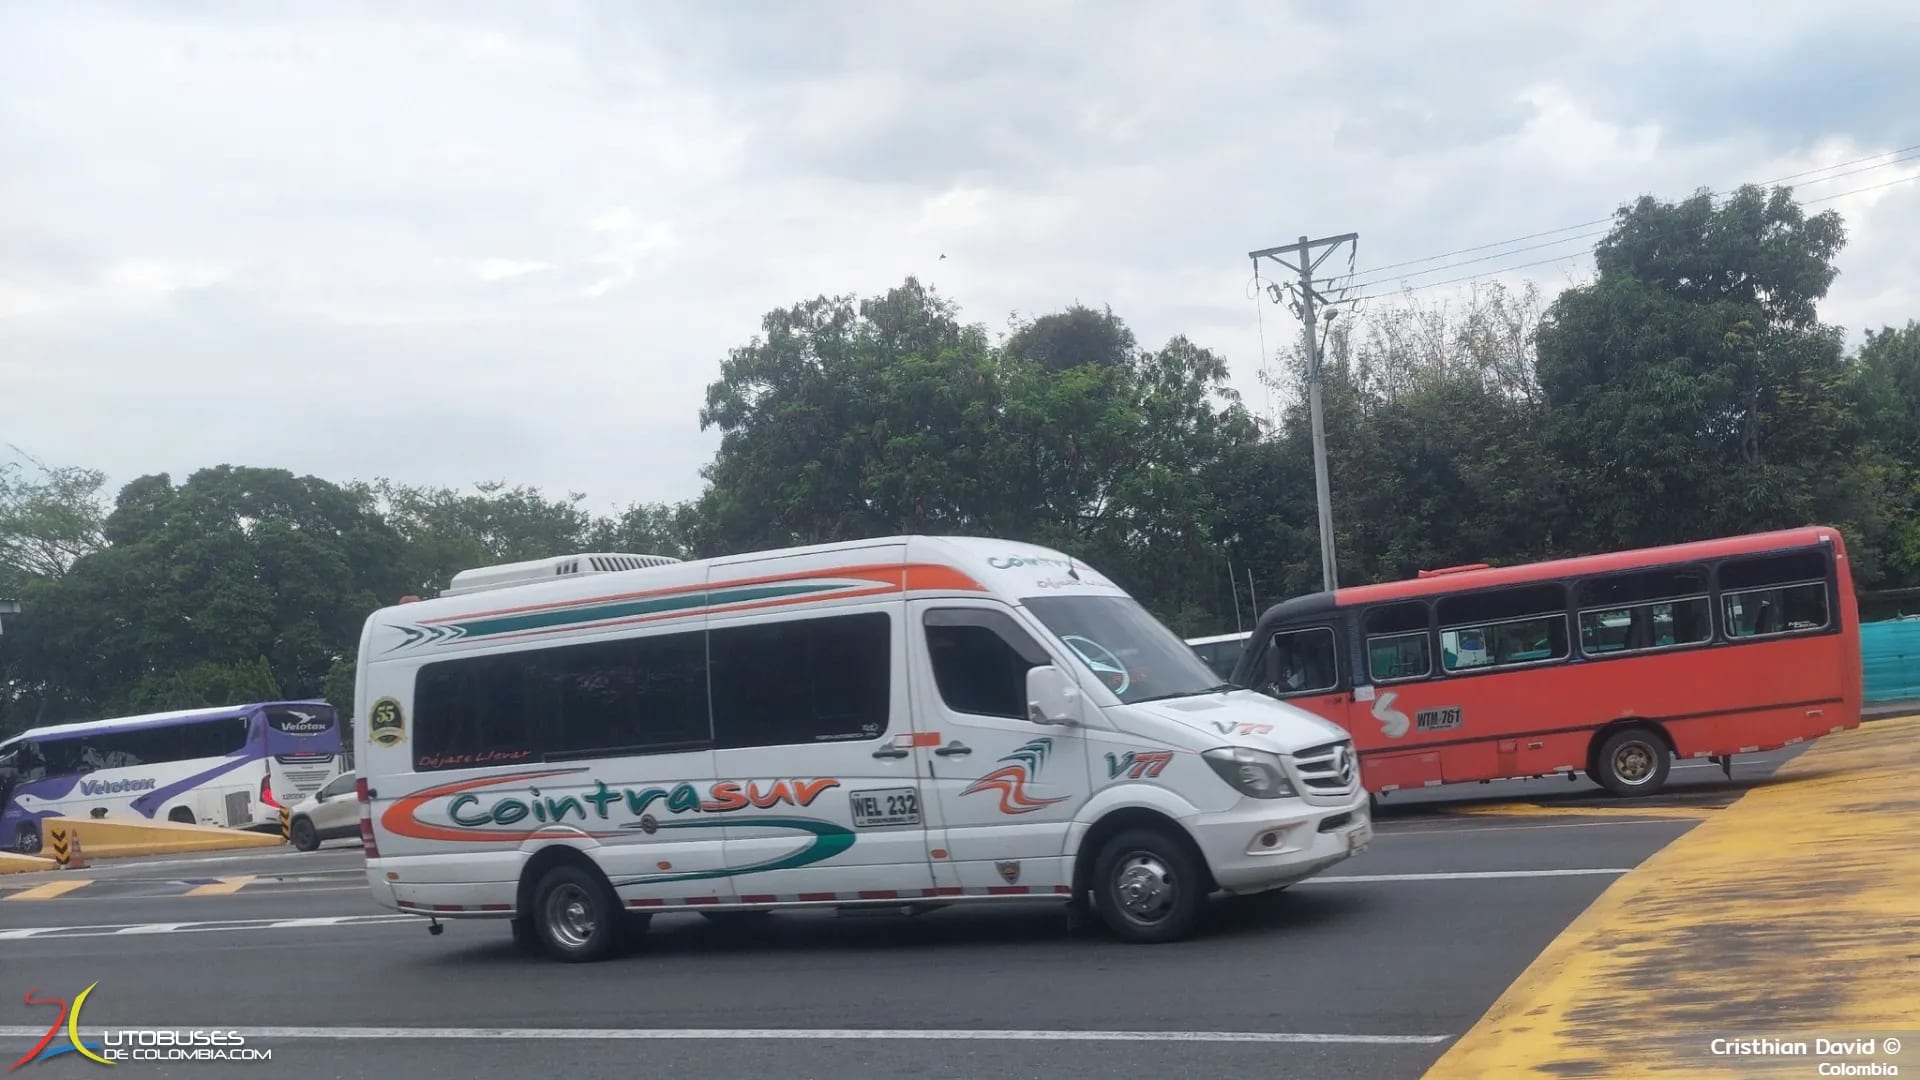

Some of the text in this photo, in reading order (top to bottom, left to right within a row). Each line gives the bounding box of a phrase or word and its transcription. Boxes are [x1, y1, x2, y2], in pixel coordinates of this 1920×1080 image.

[376, 704, 396, 723] 55
[281, 721, 326, 731] Velotax
[1211, 720, 1274, 736] V77
[1104, 750, 1174, 780] V77
[80, 777, 156, 797] Velotax
[447, 777, 840, 826] Cointrasur
[852, 794, 919, 817] WEL 232
